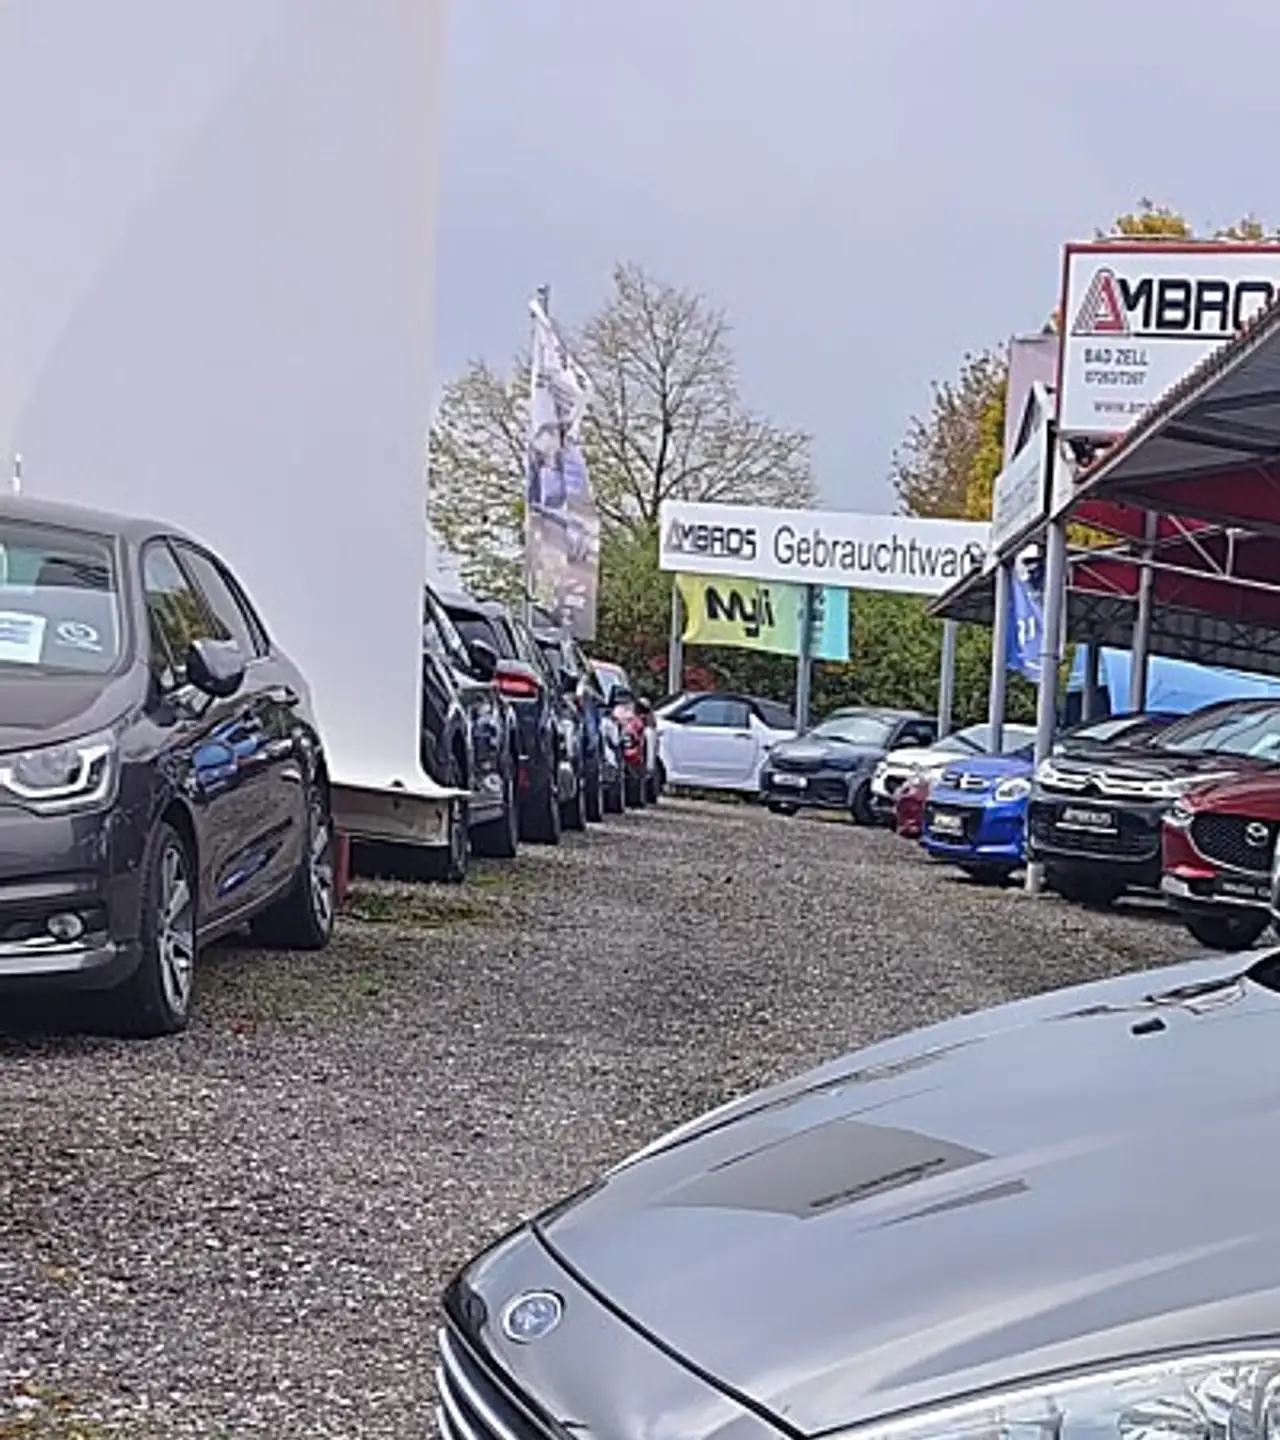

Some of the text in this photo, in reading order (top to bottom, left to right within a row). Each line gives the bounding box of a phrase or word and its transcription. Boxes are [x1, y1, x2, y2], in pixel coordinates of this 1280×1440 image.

[1084, 348, 1149, 366] BAD ZELL
[665, 516, 757, 558] AMBROS
